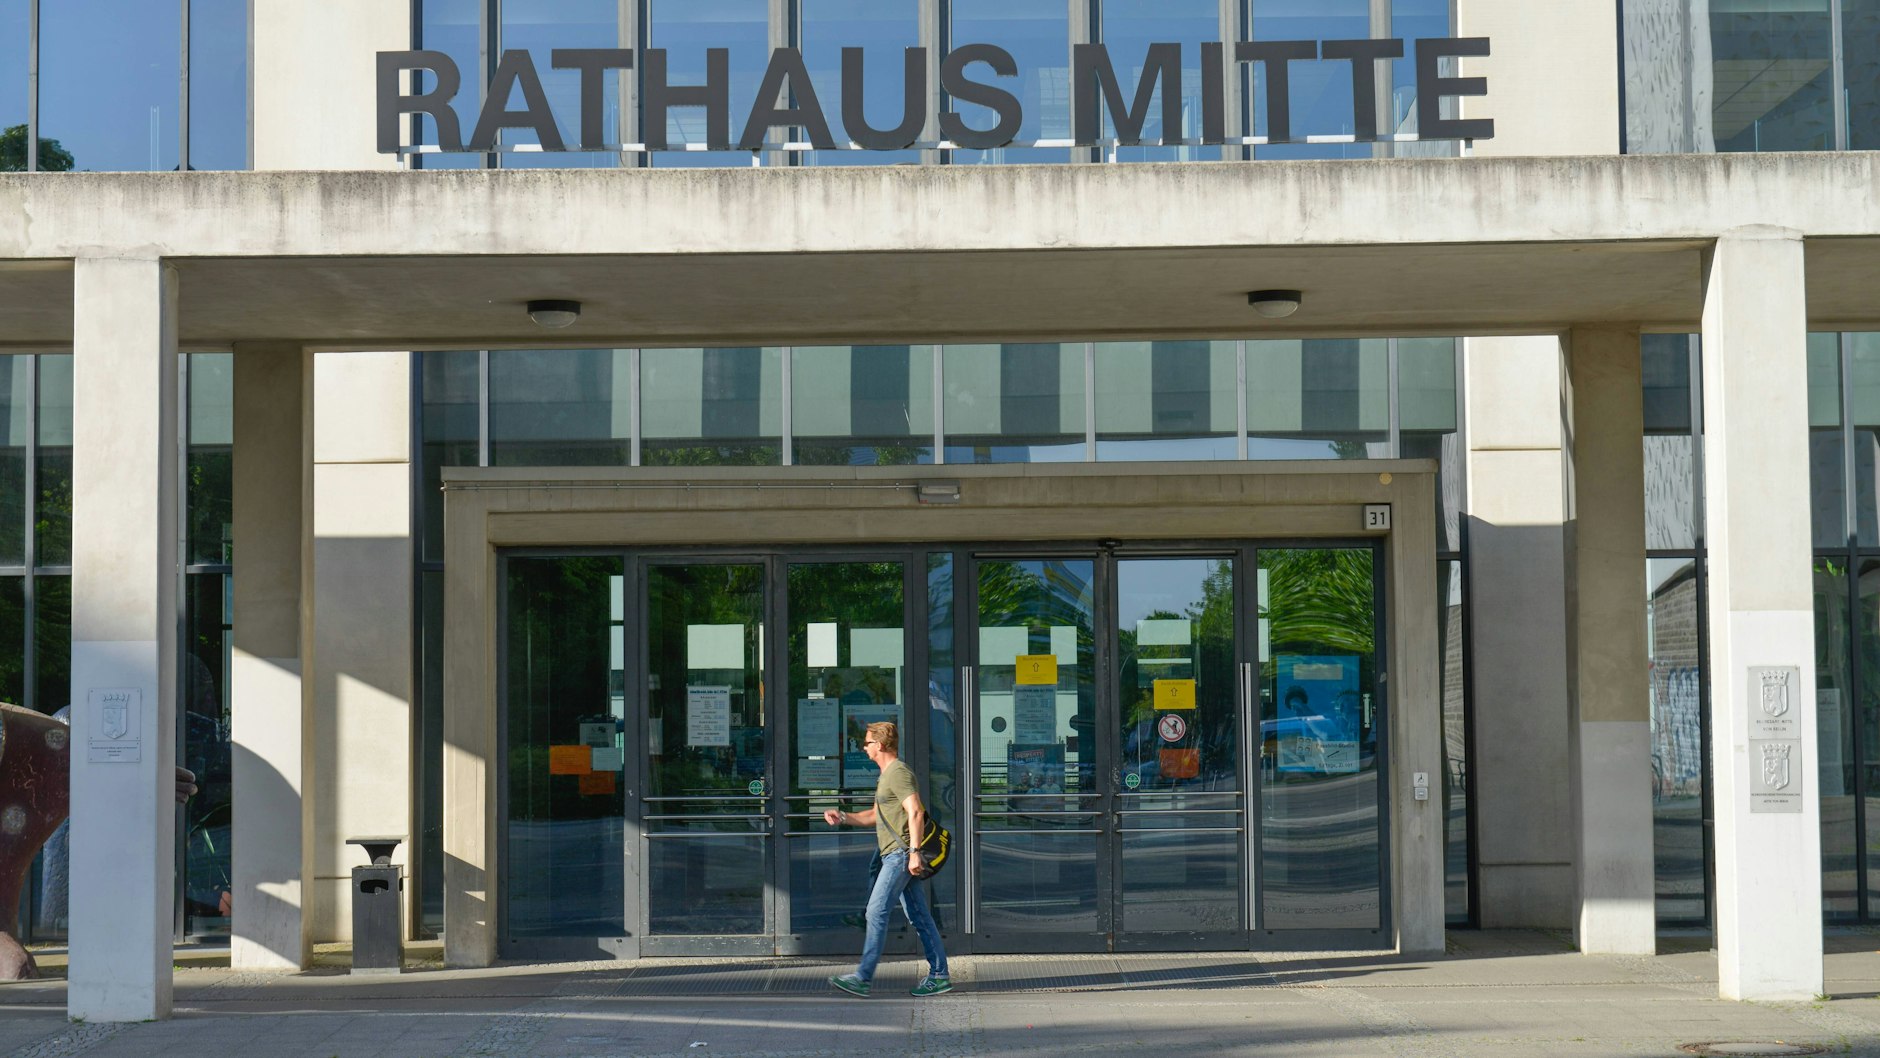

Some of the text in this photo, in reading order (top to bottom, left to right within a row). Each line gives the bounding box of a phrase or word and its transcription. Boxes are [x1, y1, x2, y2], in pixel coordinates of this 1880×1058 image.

[376, 37, 1494, 153] RATHAUS MITTE
[1370, 512, 1385, 525] 31
